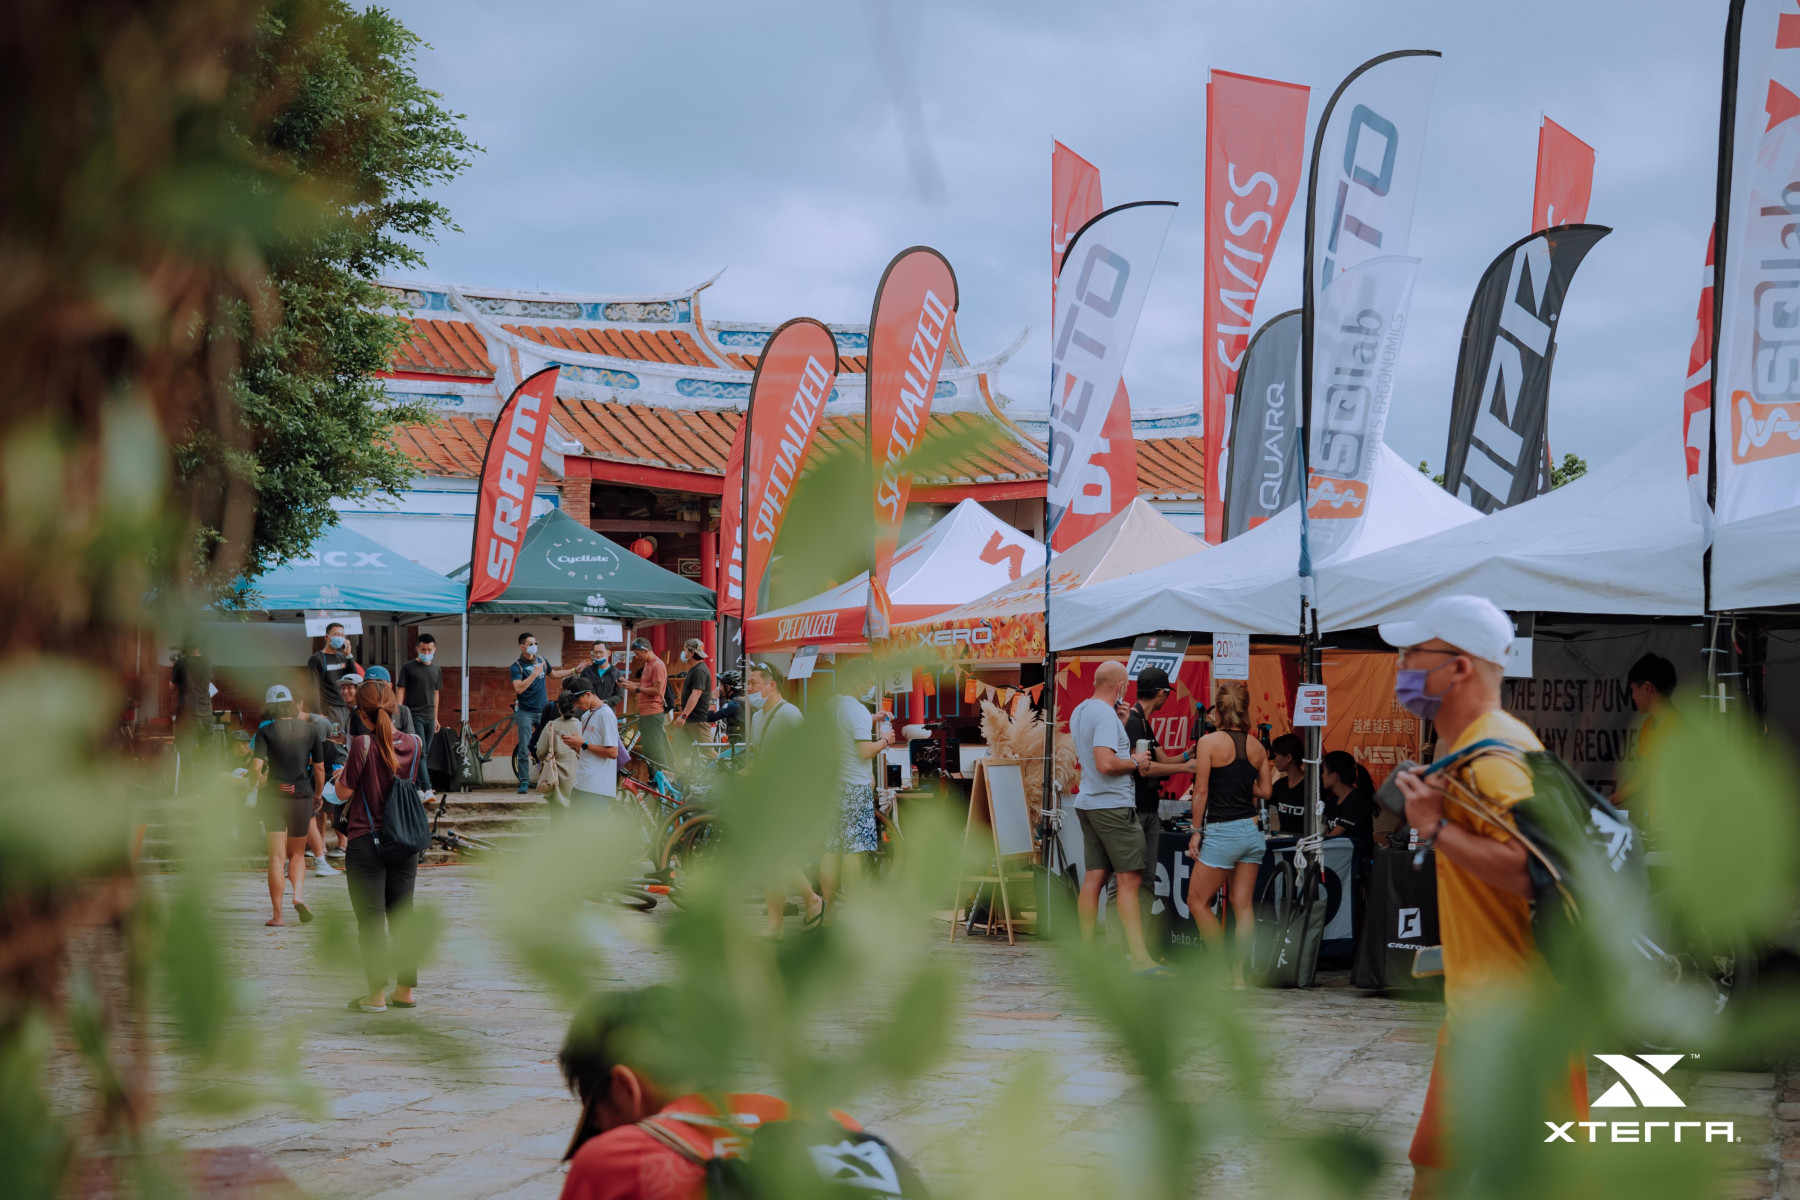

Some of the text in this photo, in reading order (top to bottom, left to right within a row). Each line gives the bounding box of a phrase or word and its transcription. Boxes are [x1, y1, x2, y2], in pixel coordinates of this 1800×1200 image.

[1217, 162, 1279, 372] SWISS
[876, 289, 951, 522] SPECIALIZED
[1047, 243, 1131, 489] BETO
[1374, 311, 1406, 416] ERGONOMICS
[1456, 235, 1552, 514] IPP
[486, 393, 542, 583] SRAM
[751, 355, 831, 546] SPECIALIZED
[1258, 380, 1286, 510] QUARQ
[557, 555, 609, 564] Cycliste
[774, 612, 839, 642] SPECIALIZED
[918, 626, 992, 649] XERO
[1505, 679, 1638, 713] THE BEST PUM
